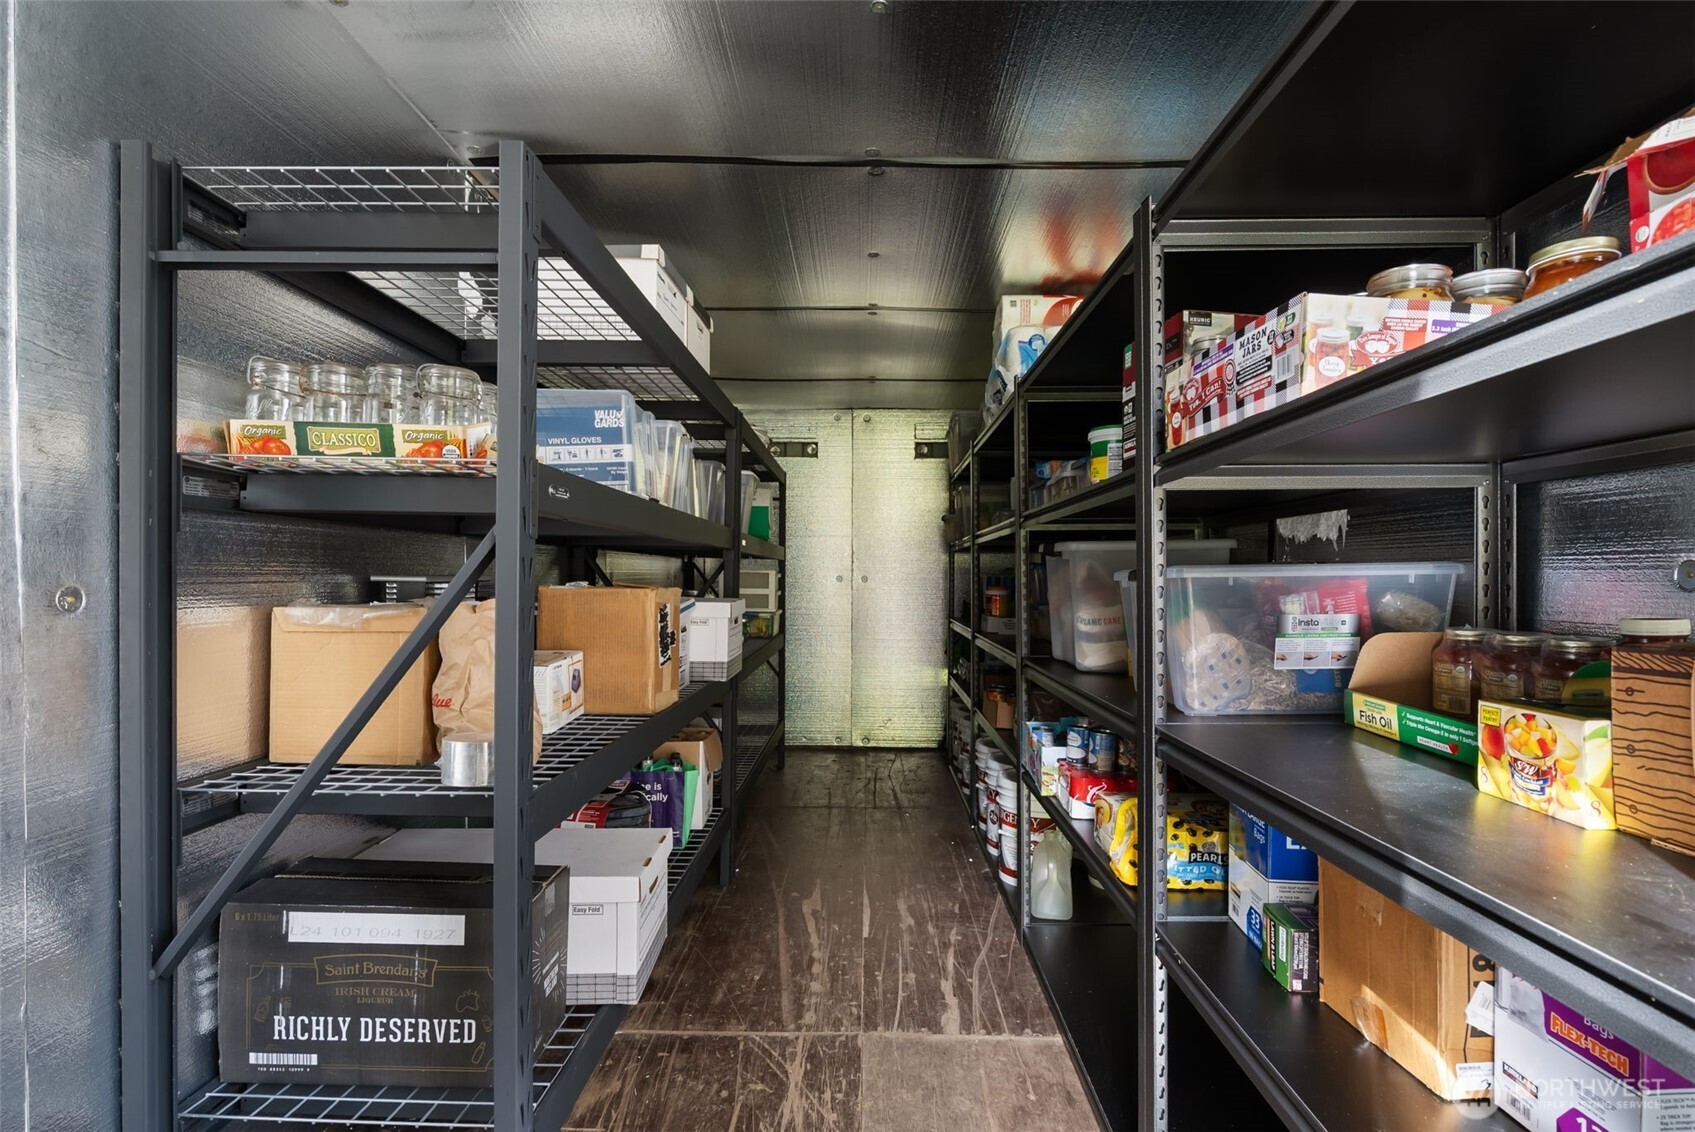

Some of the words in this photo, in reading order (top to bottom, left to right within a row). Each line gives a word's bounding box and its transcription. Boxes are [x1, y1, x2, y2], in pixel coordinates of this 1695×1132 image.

[1239, 326, 1268, 351] MASON
[1242, 340, 1262, 359] JARS
[594, 410, 615, 419] VALU
[594, 419, 625, 428] GARDS
[244, 425, 283, 437] Organic
[404, 430, 445, 441] Organic
[312, 431, 376, 447] CLASSICO
[548, 437, 570, 445] VINYL
[571, 436, 602, 444] GLOVES
[1359, 709, 1377, 725] Fish
[1379, 716, 1393, 730] Oil
[1406, 712, 1424, 722] Supports
[1424, 718, 1436, 726] Heart
[1406, 720, 1417, 728] Triple
[1481, 766, 1488, 783] 8
[653, 781, 662, 791] is
[1591, 800, 1602, 817] 8
[573, 906, 587, 914] Easy
[263, 913, 279, 922] Liter
[290, 926, 321, 936] L24
[332, 927, 361, 937] 101
[369, 928, 401, 938] 094
[414, 928, 457, 940] 1927
[324, 962, 360, 977] Saint
[335, 987, 369, 996] IRISH
[372, 987, 416, 997] CREAM
[357, 996, 394, 1005] LIQUEUR
[273, 1015, 351, 1042] RICHLY
[359, 1017, 477, 1044] DESERVED
[1550, 1010, 1630, 1078] FLEX-TECH
